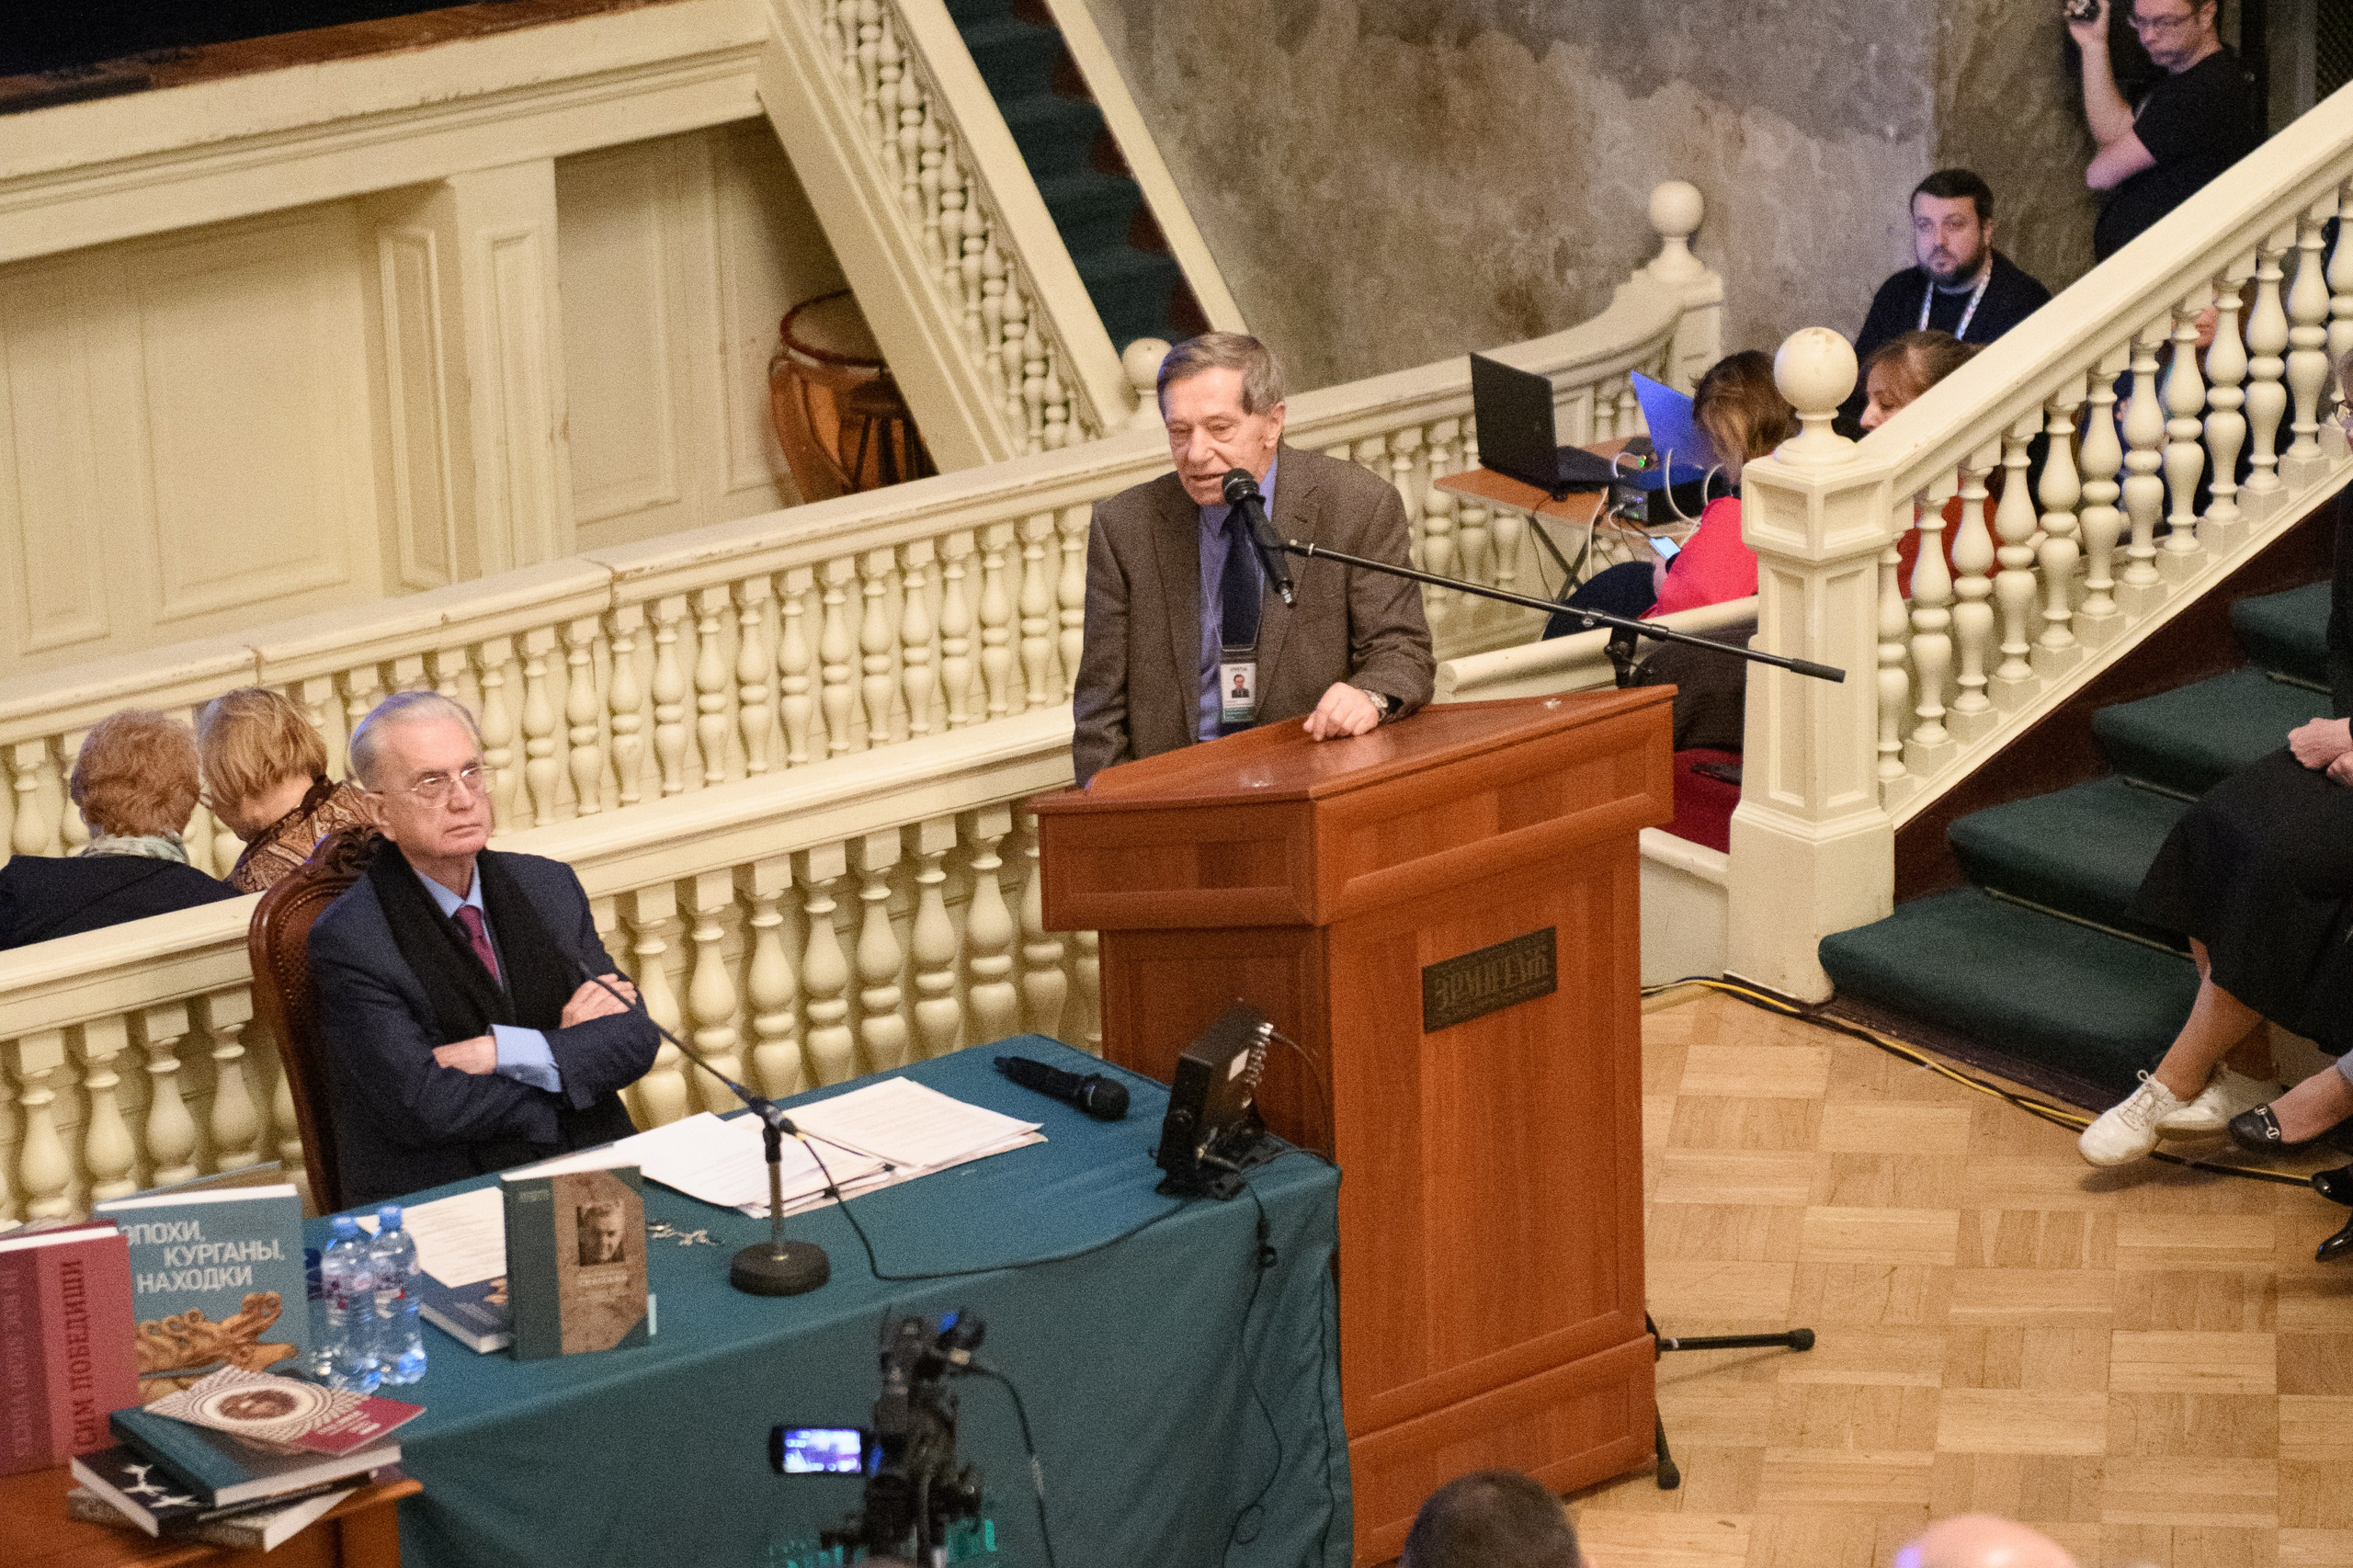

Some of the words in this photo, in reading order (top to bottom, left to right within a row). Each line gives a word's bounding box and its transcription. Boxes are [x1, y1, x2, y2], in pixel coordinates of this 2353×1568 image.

[164, 1239, 286, 1268] КУРГАНЫ,
[137, 1265, 254, 1294] НАХОДКИ
[61, 1260, 92, 1391] ПОБЕДИШИ
[74, 1397, 98, 1447] СИМ
